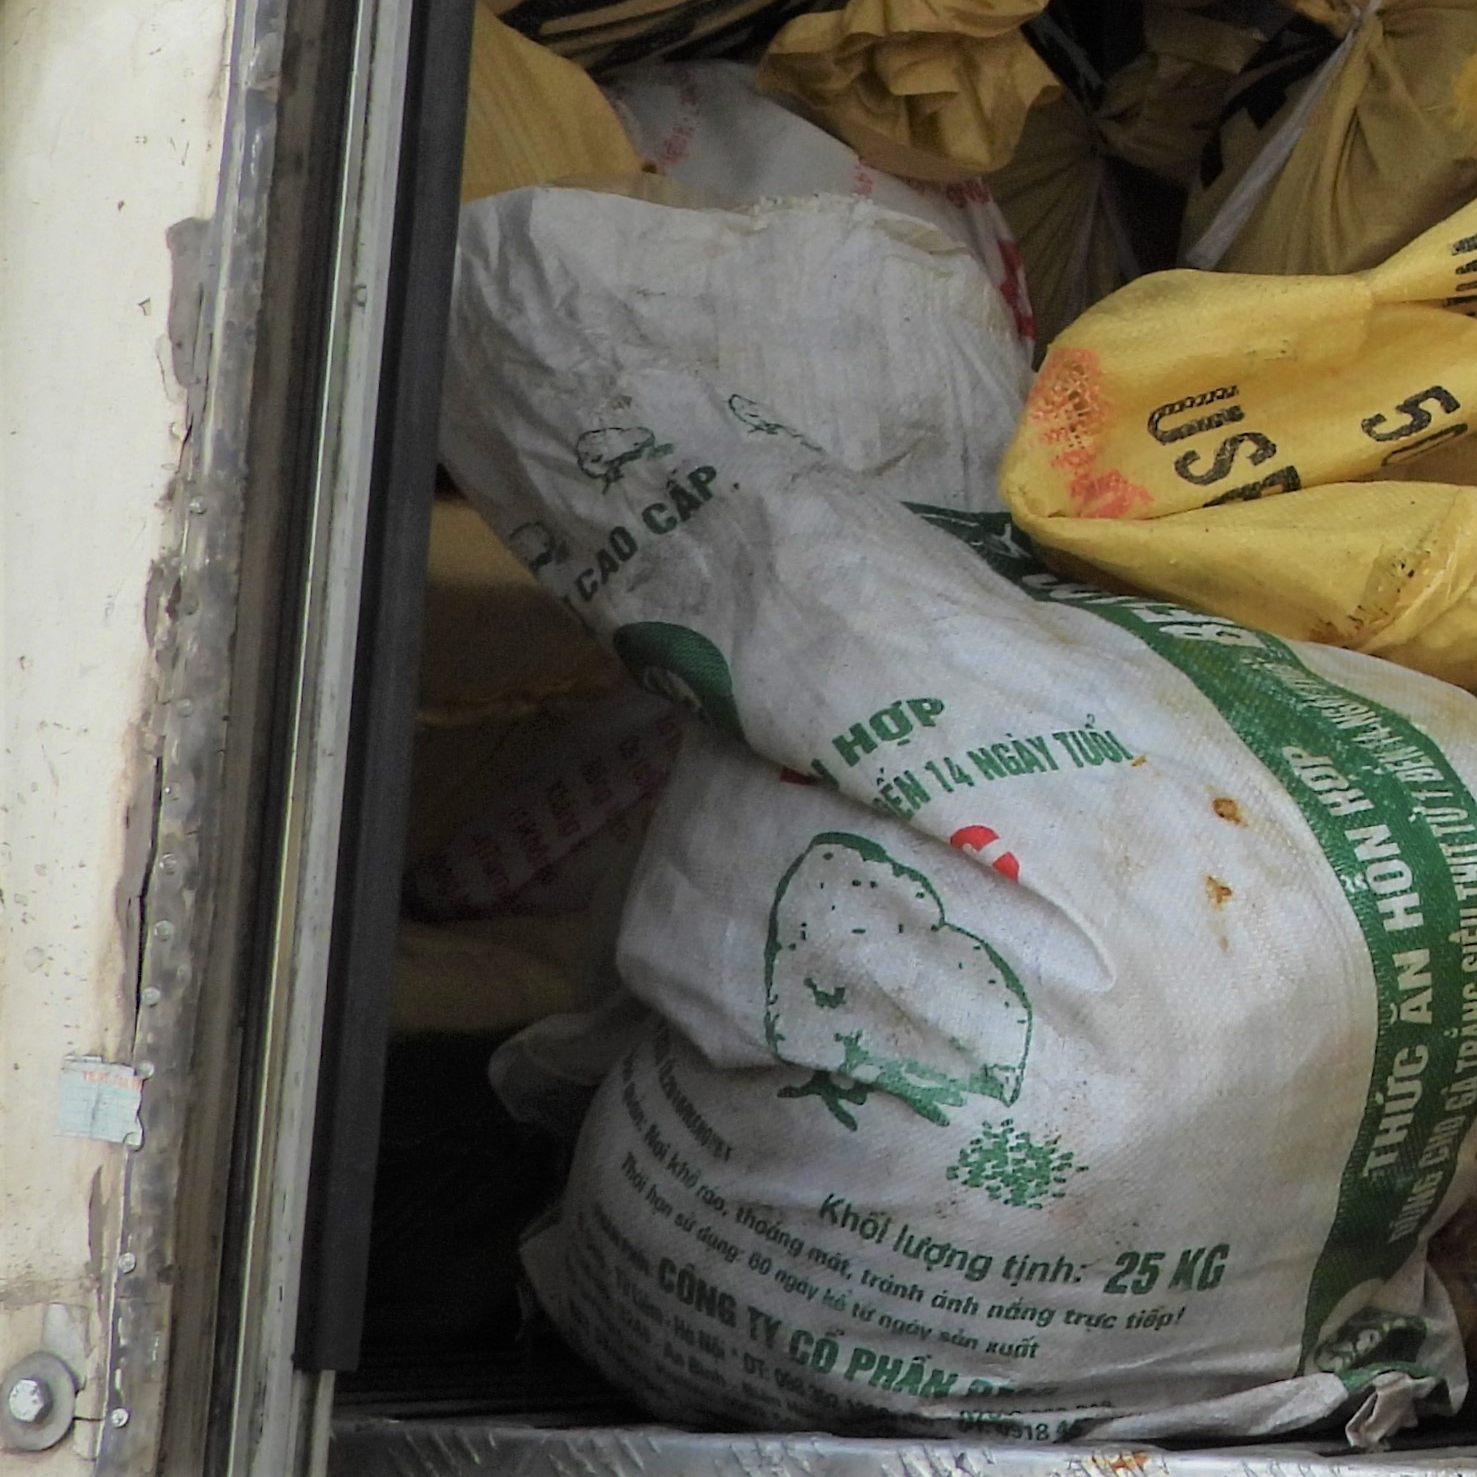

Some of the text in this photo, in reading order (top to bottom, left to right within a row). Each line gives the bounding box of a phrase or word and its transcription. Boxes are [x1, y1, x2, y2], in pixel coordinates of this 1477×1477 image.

[576, 525, 640, 604] CAO
[832, 695, 946, 768] HỢP
[924, 755, 976, 794] 14
[967, 732, 1061, 782] NGÀY
[1052, 713, 1135, 768] TUỔI
[1380, 948, 1432, 1026] ĂN
[1362, 1043, 1429, 1179] THỨC
[735, 1206, 806, 1257] thoáng
[860, 1268, 926, 1305] tránh
[931, 1287, 982, 1315] ánh
[817, 1190, 1231, 1297] Khối lượng tịnh: 25 KG
[659, 1256, 738, 1329] CÔNG
[747, 1305, 783, 1351] TY
[985, 1333, 1042, 1361] xuất
